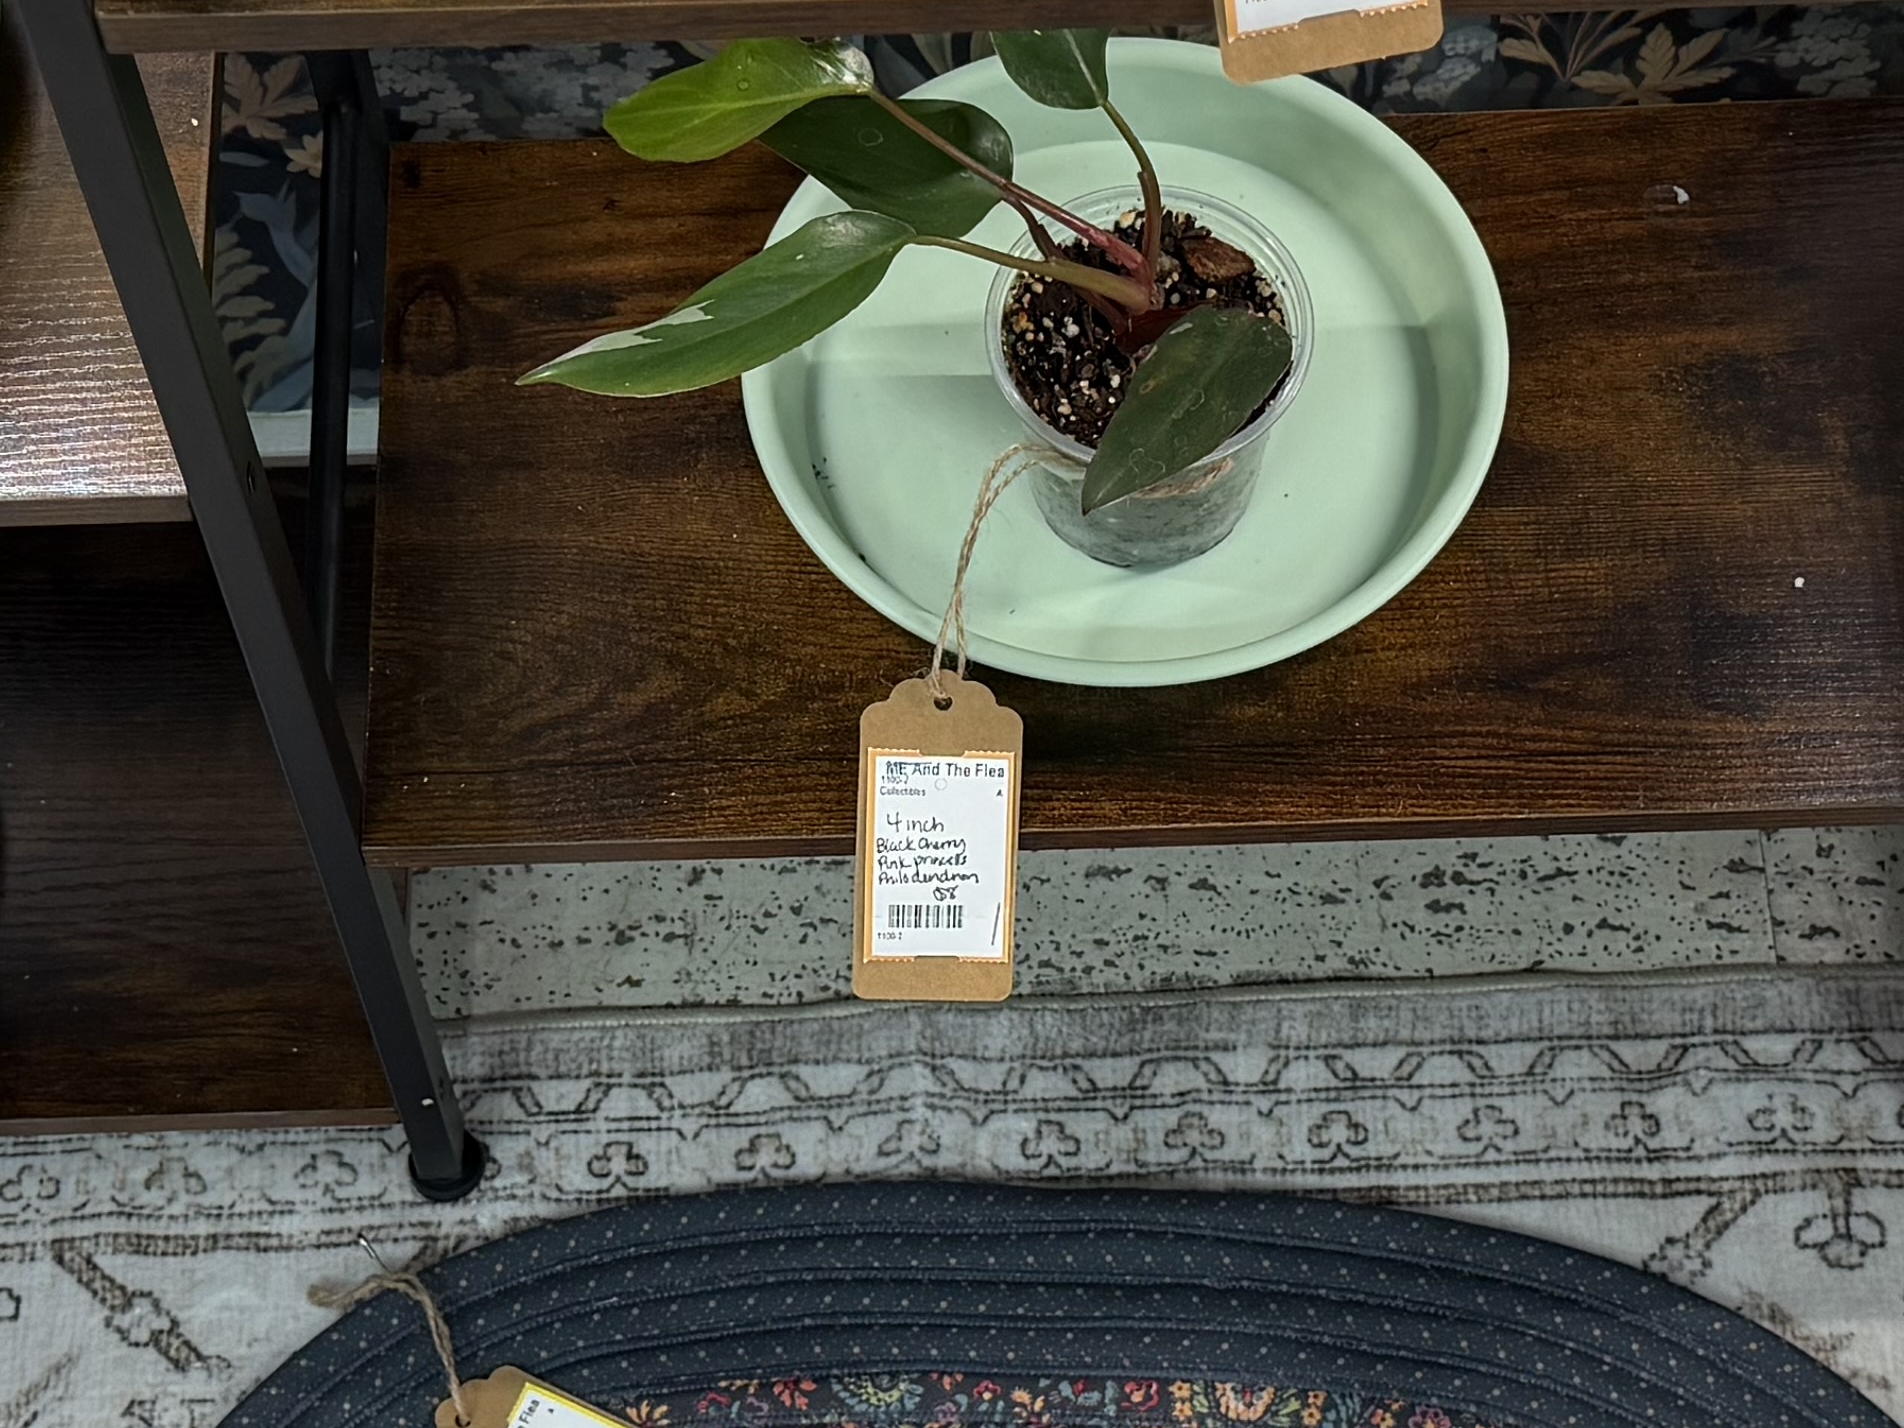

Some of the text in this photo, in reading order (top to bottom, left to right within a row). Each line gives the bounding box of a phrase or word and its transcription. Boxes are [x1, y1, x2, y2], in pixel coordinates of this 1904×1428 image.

[886, 761, 1005, 778] ME And The Flea
[887, 812, 944, 833] 4 inch
[876, 836, 916, 854] Black
[519, 1399, 540, 1424] Flea
